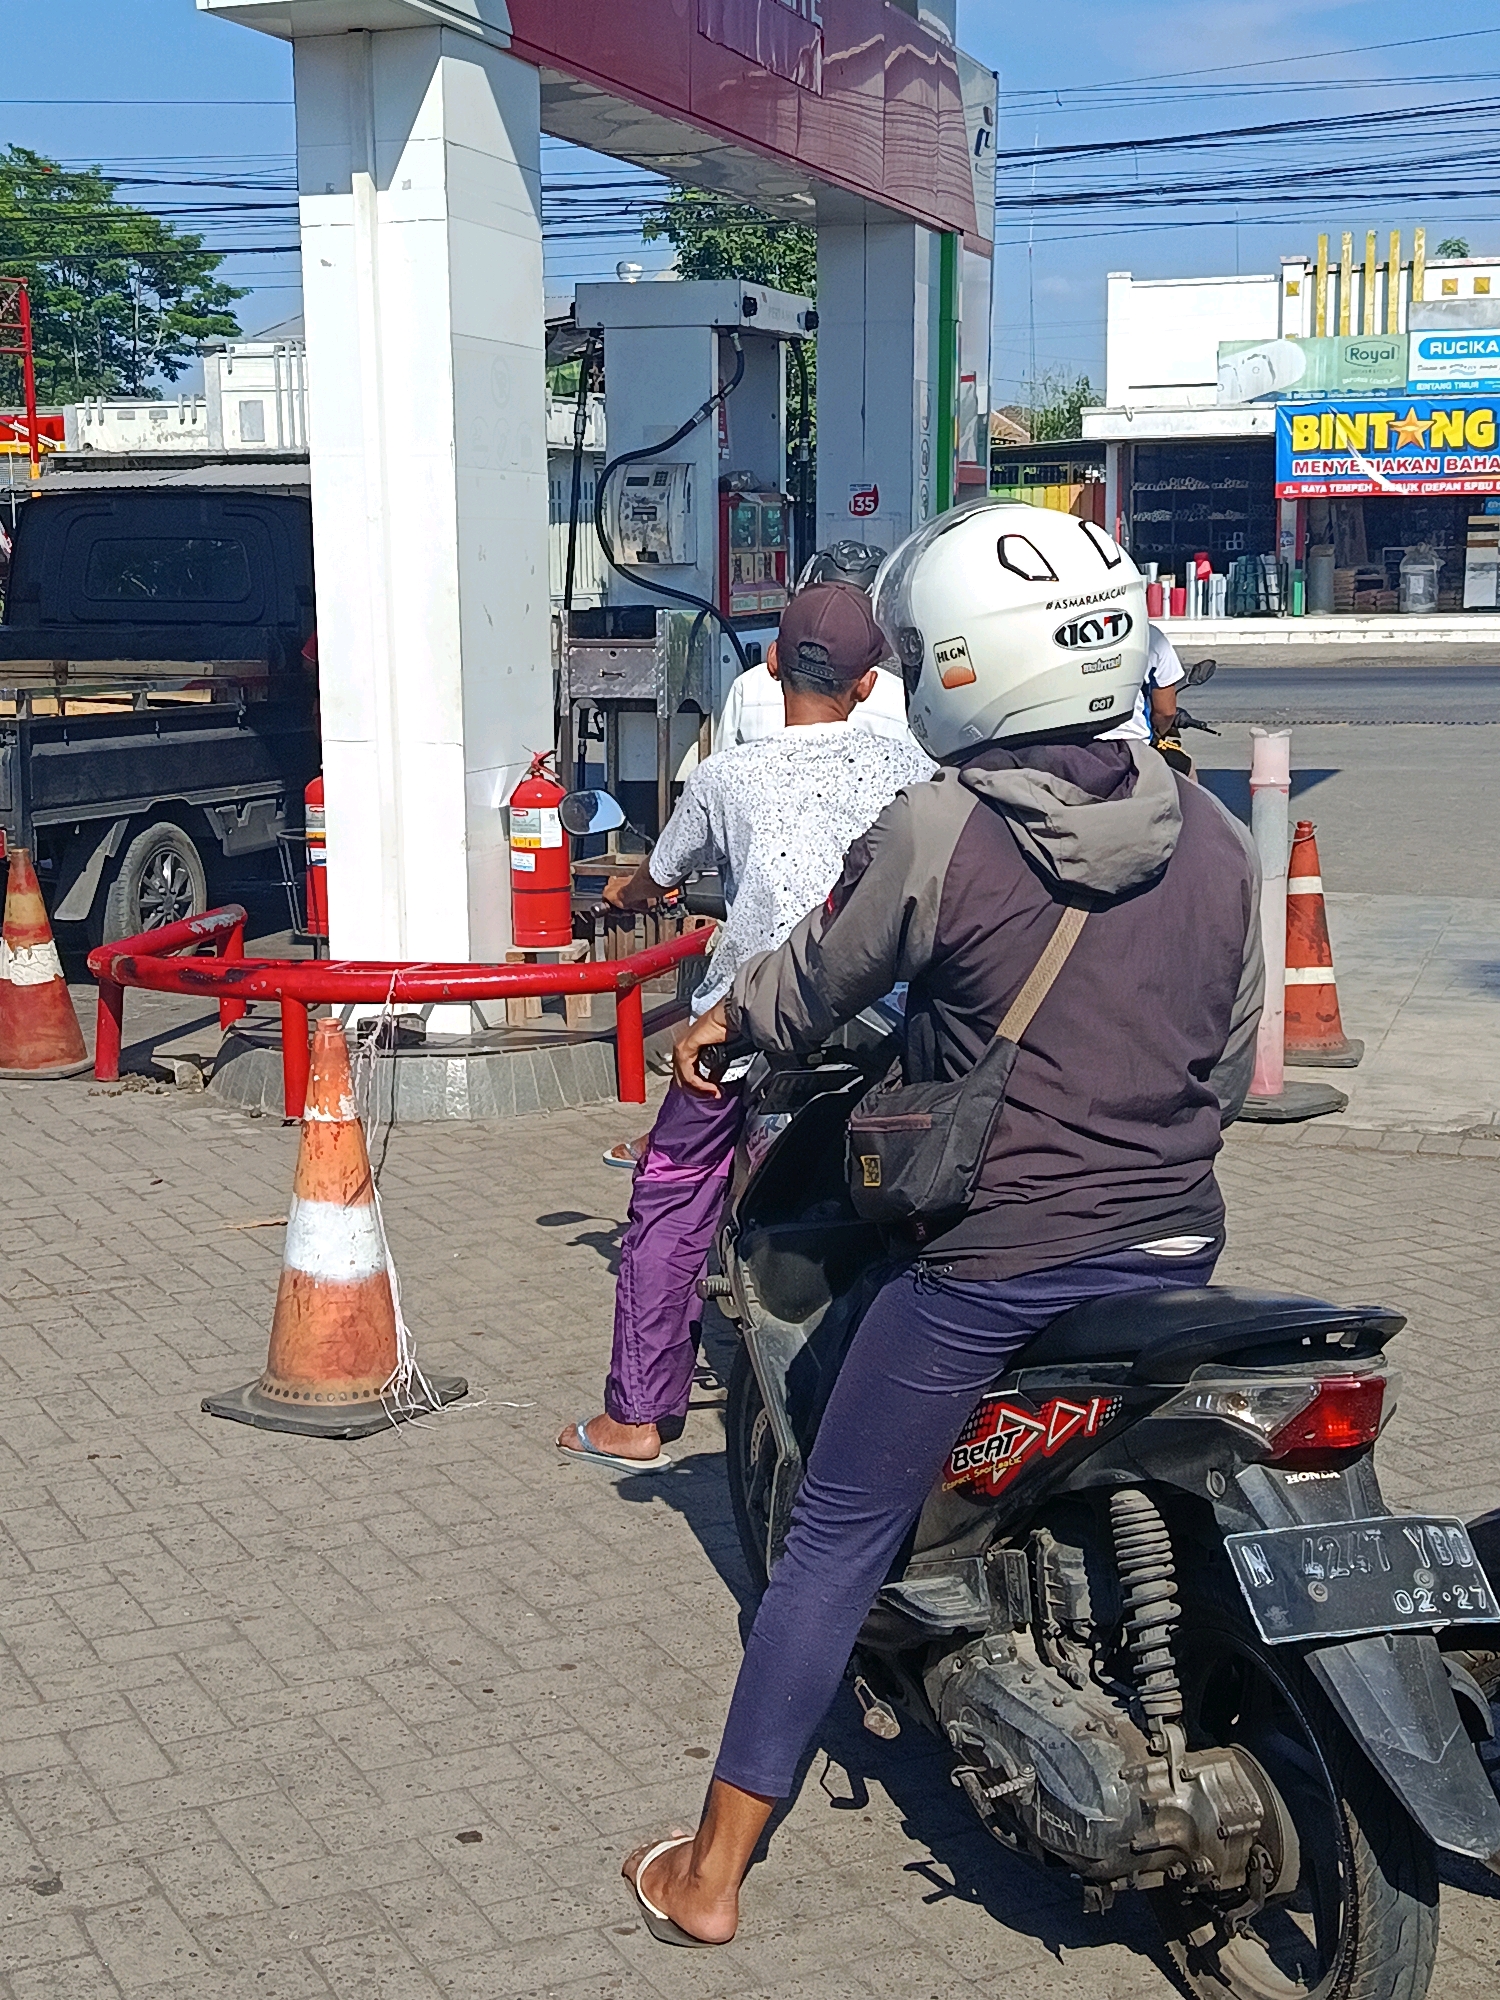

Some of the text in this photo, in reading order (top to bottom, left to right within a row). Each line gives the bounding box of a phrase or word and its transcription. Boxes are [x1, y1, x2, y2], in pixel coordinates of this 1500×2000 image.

[1350, 347, 1395, 363] Royal
[1430, 340, 1499, 355] RUCIKA
[850, 496, 875, 512] 135
[1046, 585, 1127, 610] #ASMARAKACAU
[936, 645, 966, 663] HLGN
[1092, 699, 1112, 709] DOT
[1285, 1471, 1341, 1485] HONDA
[1241, 1543, 1275, 1588] N
